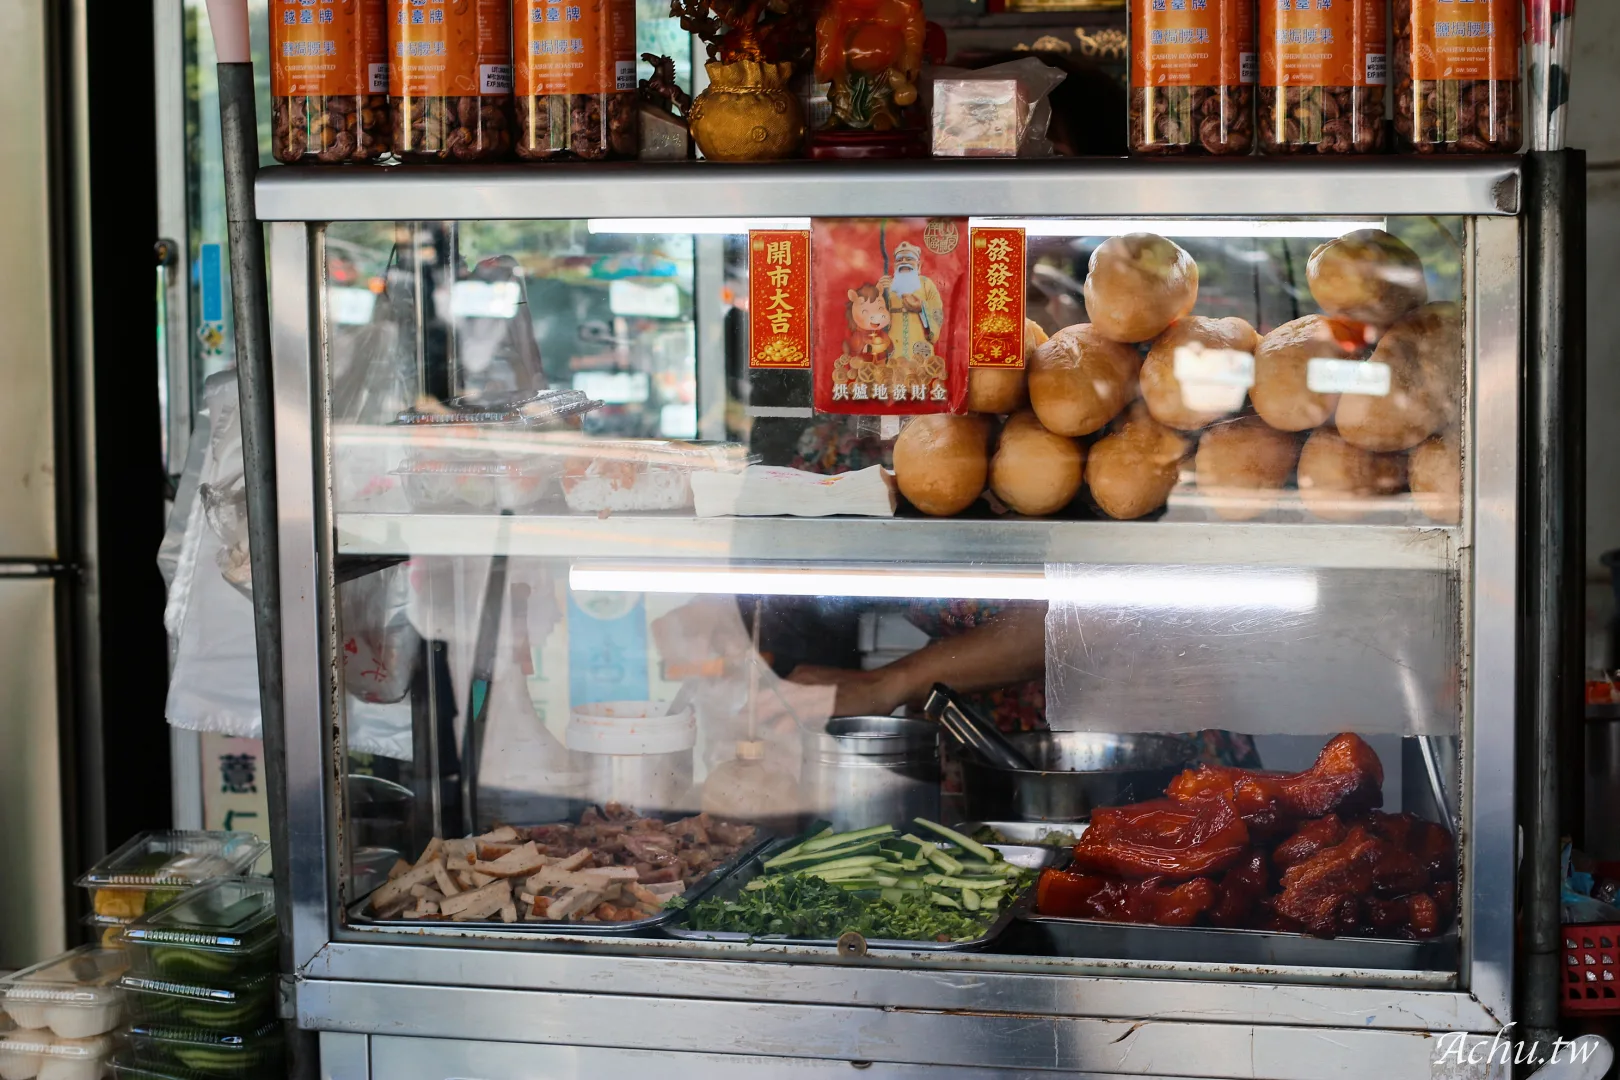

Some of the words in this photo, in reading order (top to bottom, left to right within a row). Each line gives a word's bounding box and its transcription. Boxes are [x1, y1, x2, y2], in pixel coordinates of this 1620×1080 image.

[766, 240, 794, 334] 開市大吉
[984, 237, 1014, 313] 發發發
[832, 383, 947, 401] 烘爐地發財金
